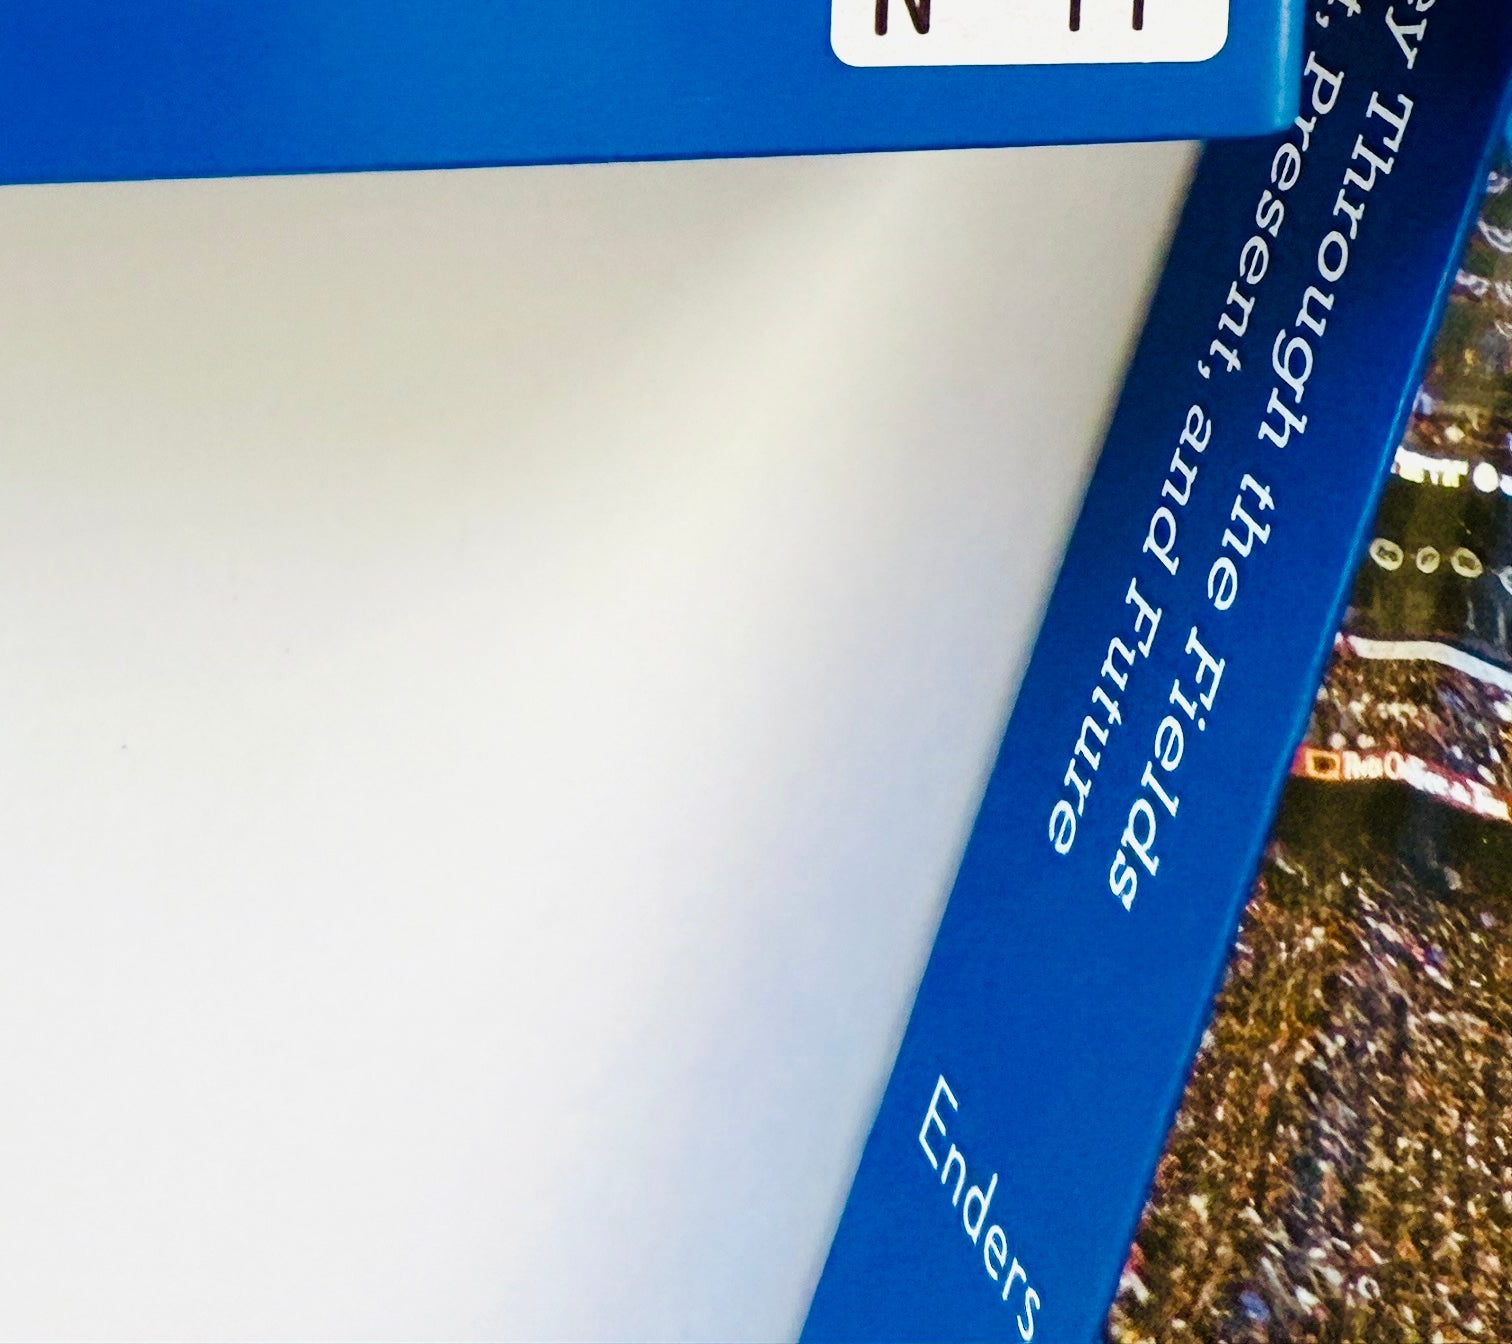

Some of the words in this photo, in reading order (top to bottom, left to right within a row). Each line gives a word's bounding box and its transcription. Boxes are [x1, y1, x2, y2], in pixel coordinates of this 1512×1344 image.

[1198, 51, 1344, 379] Present,
[1258, 91, 1414, 449] Through
[1143, 404, 1211, 576] and
[1207, 473, 1275, 611] the
[1049, 577, 1162, 855] Future
[1109, 626, 1226, 911] Fields
[918, 1074, 1041, 1343] Enders
